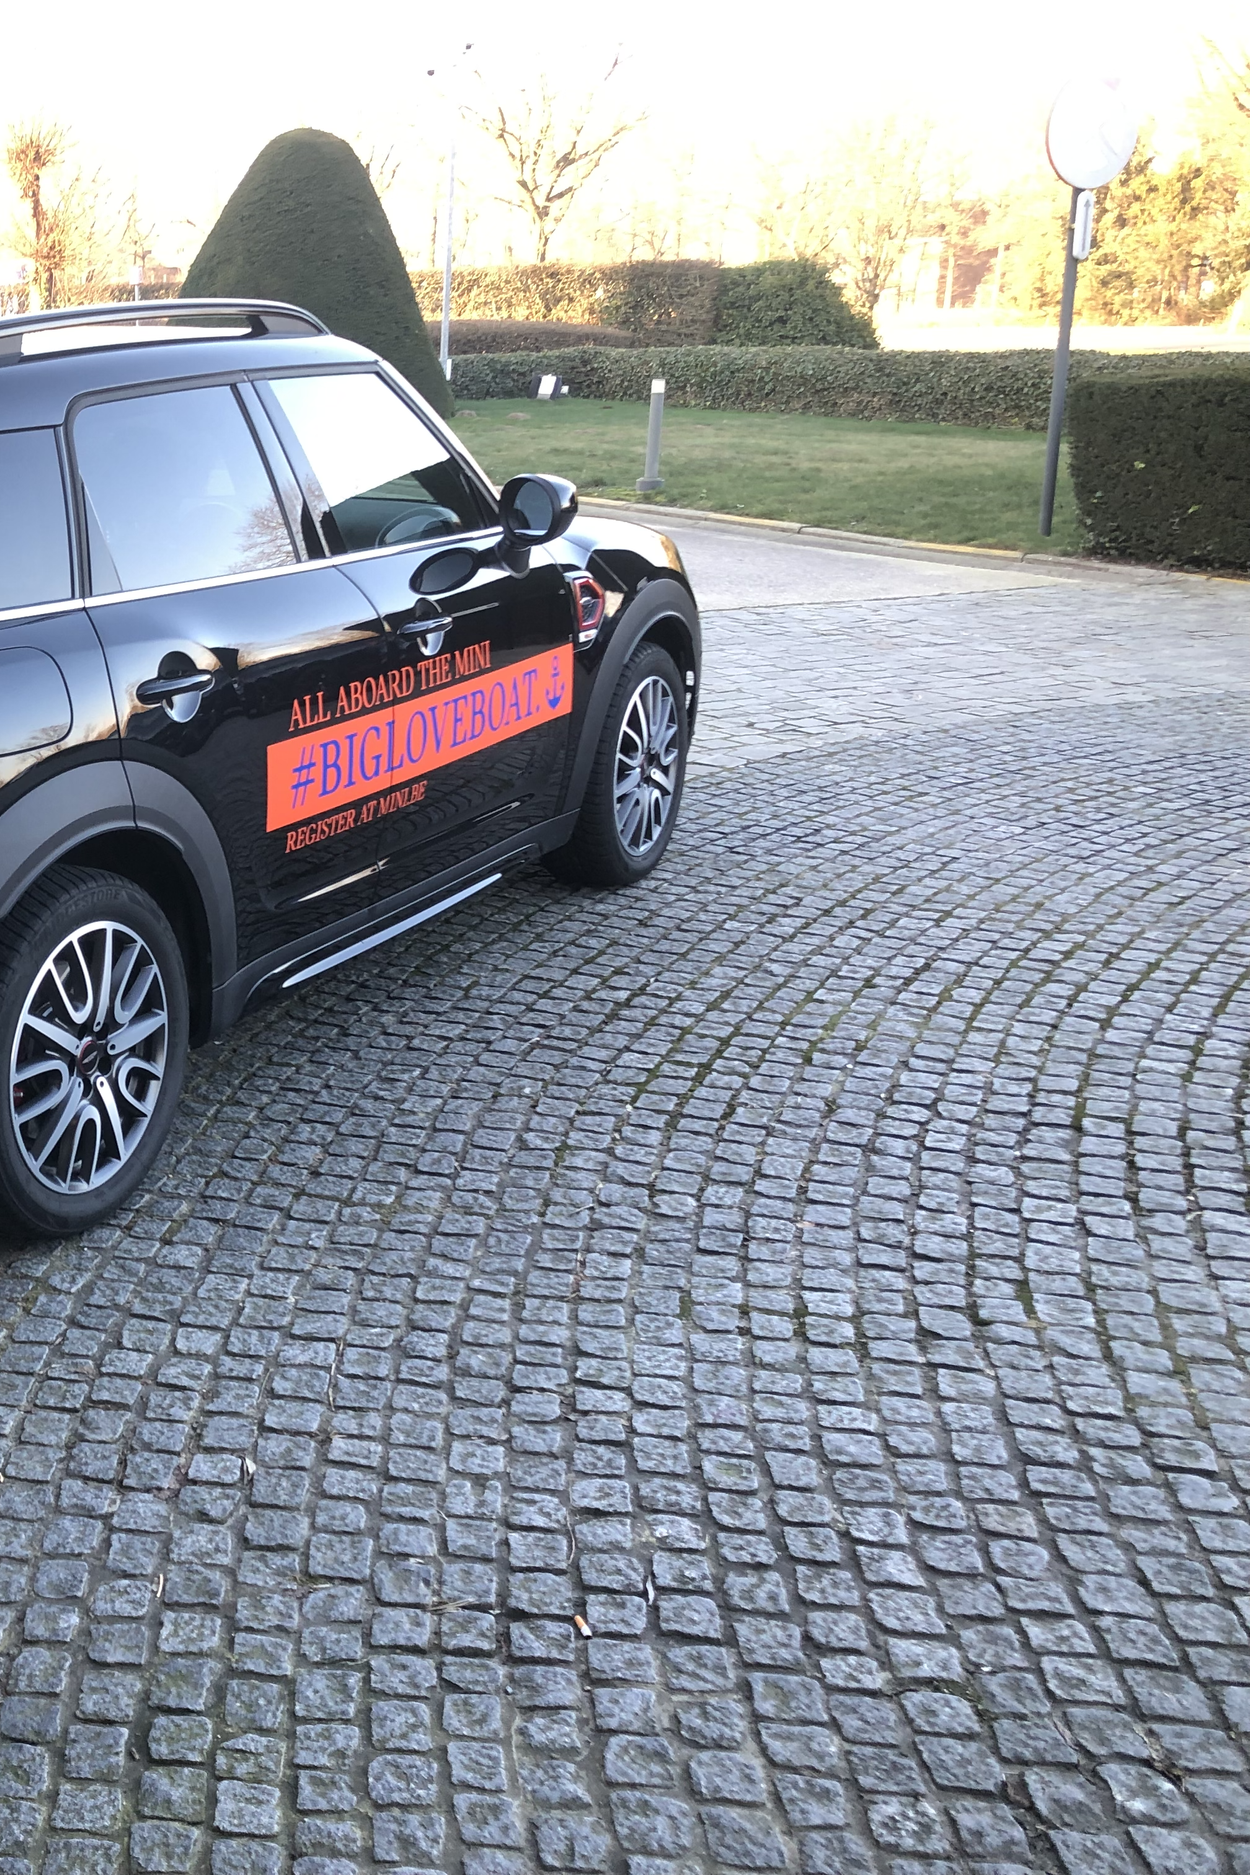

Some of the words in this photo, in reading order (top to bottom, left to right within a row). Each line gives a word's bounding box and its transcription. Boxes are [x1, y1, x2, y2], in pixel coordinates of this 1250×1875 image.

[288, 691, 331, 732] ALL
[335, 665, 415, 718] ABOARD
[417, 653, 452, 691] THE
[454, 640, 491, 679] MINI
[290, 668, 540, 809] #BIGLOVEBOAT.
[285, 809, 358, 853] REGISTER
[357, 800, 377, 825] AT
[377, 780, 427, 817] MINI.BE
